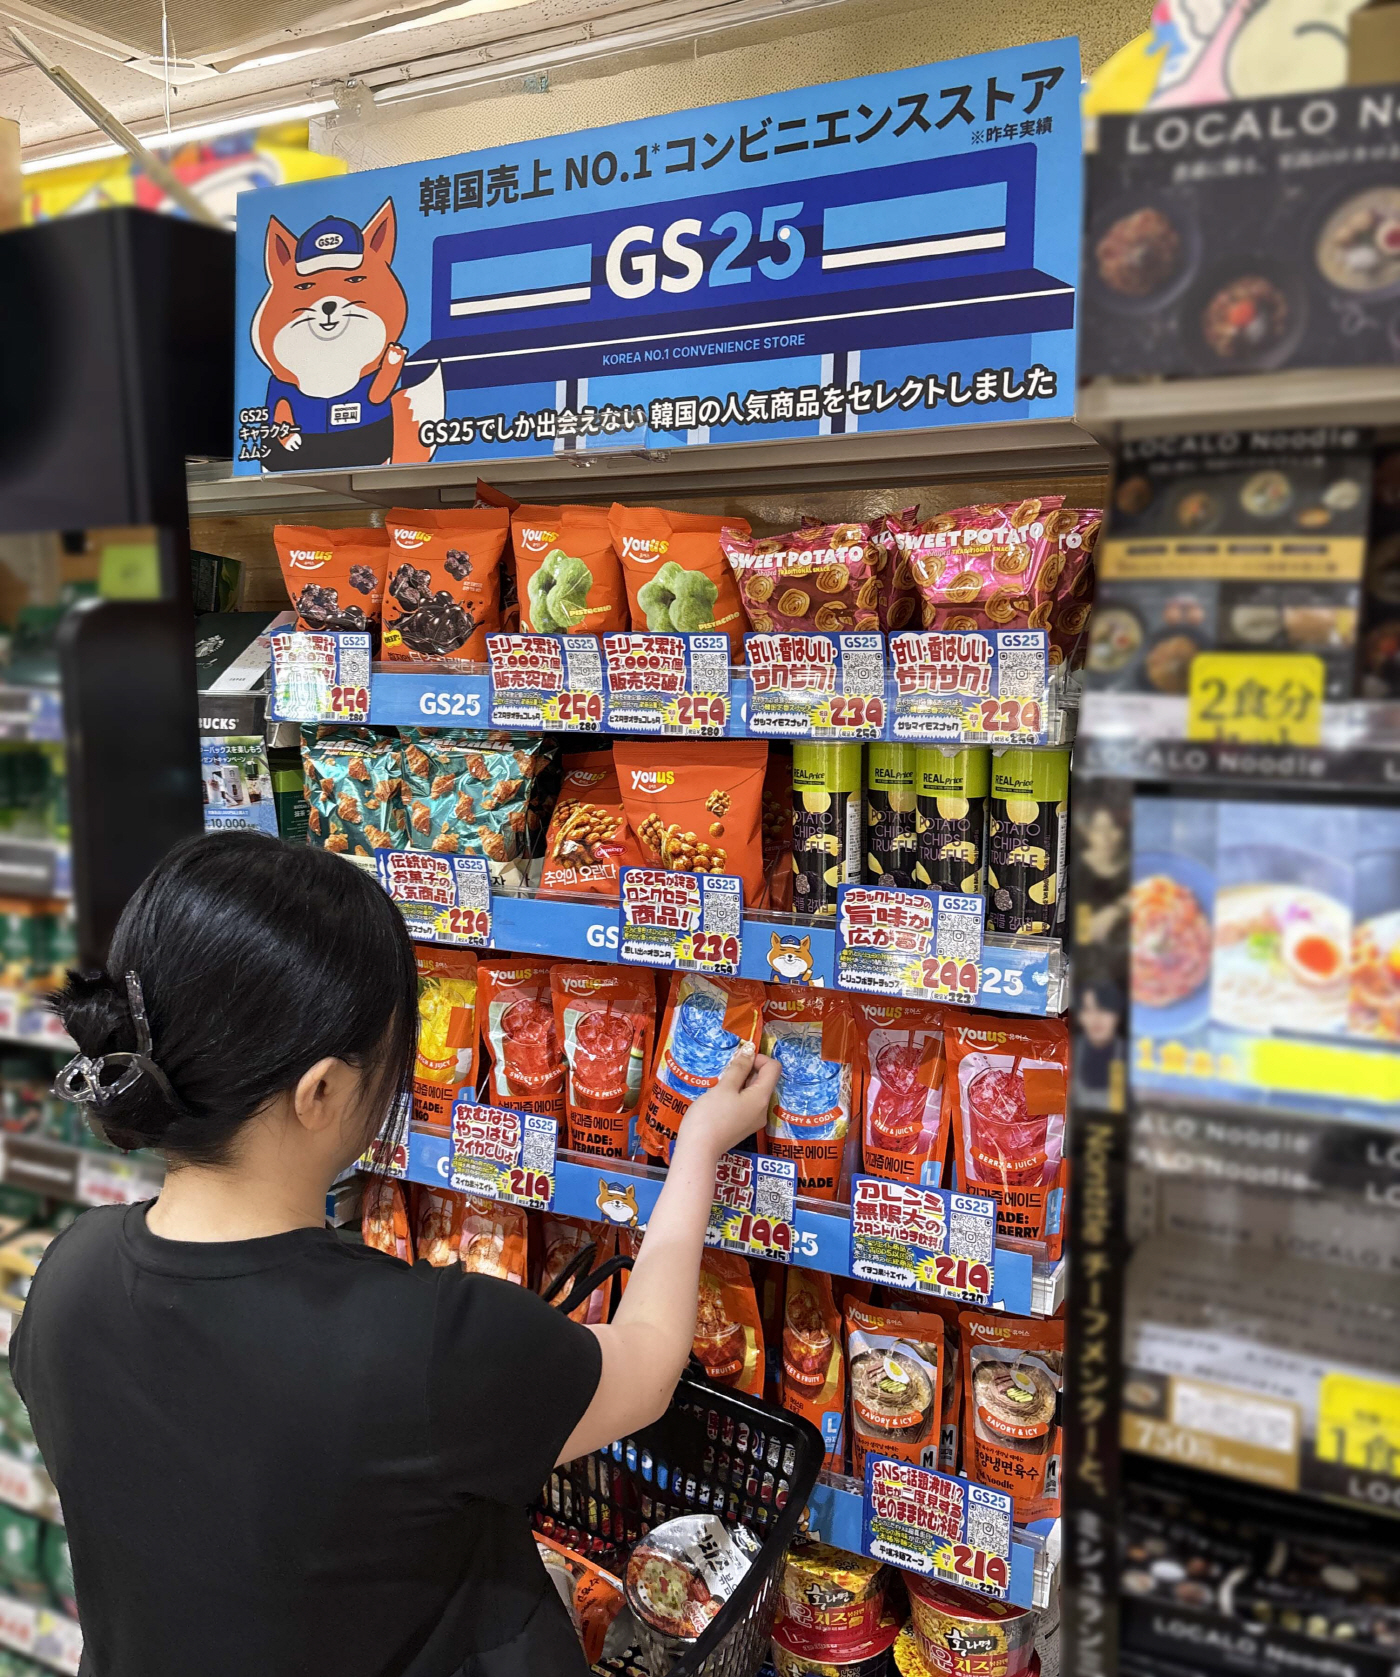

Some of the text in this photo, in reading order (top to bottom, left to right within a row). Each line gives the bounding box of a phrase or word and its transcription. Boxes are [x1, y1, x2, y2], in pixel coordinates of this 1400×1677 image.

[970, 115, 1053, 146] ※昨年実績
[1126, 100, 1338, 155] LOCALO
[419, 158, 555, 217] 韓国売上
[664, 65, 1065, 174] コンビニエンスストア
[316, 234, 341, 247] GS25
[604, 201, 807, 298] GS25
[602, 333, 806, 366] KOREA NO.1 CONVENIENCE STORE
[239, 408, 269, 423] GS25
[419, 367, 1056, 447] GS25でしか出会えない 韓国の人気商品をセレクトしました
[239, 423, 301, 441] キャラクター
[1251, 429, 1358, 451] Noodle
[239, 445, 272, 459] ムムシ
[394, 528, 433, 547] youus
[521, 528, 560, 548] youus
[896, 522, 1044, 550] SWEET POTATO
[622, 536, 670, 557] youus
[289, 550, 333, 567] youus
[730, 545, 864, 570] SWEET POTATO
[569, 604, 612, 617] PISTACHIO
[698, 612, 740, 632] PISTACHIO
[342, 636, 367, 646] GS25
[488, 637, 560, 657] シリーズ累計
[567, 639, 594, 650] GS25
[605, 636, 685, 657] シリーズ累計
[693, 637, 724, 649] GS25
[844, 636, 878, 648] GS25
[1001, 634, 1040, 647] GS25
[608, 655, 684, 671] 3,000万個
[608, 670, 685, 692] 販売突破!
[419, 692, 481, 716] GS25
[557, 693, 603, 721] 259
[1199, 677, 1315, 723] 2食分
[677, 696, 725, 726] 259
[829, 696, 884, 728] 239
[980, 699, 1042, 733] 239
[631, 770, 675, 790] youus
[793, 768, 808, 779] REAL
[874, 767, 895, 778] REAL
[923, 772, 944, 784] REAL
[995, 774, 1014, 785] REAL
[793, 825, 824, 839] CHIPS
[874, 825, 911, 839] CHIPS
[919, 815, 971, 833] POTATO
[922, 831, 962, 848] CHIPS
[993, 835, 1031, 852] CHIPS
[390, 854, 448, 872] 伝統的な
[919, 845, 969, 863] TRUFFLE
[457, 859, 484, 870] GS25
[393, 870, 451, 888] お菓子の
[543, 863, 617, 888] 추억의 오란다
[706, 878, 736, 890] GS25
[390, 885, 455, 905] 人気商品!
[626, 887, 700, 906] ロングセラー
[845, 891, 932, 910] ブラックトリュフの
[942, 897, 978, 911] GS25
[449, 908, 489, 937] 239
[631, 904, 690, 928] 商品!
[844, 905, 930, 929] 旨味が
[691, 932, 739, 965] 239
[848, 928, 928, 952] 広がる!
[489, 969, 532, 985] youus
[922, 958, 979, 994] 299
[982, 967, 1024, 996] 25
[861, 1004, 903, 1020] youus
[958, 1026, 1007, 1043] youus
[667, 1058, 711, 1086] ZESTY COOL
[575, 1081, 595, 1096] SWEET
[456, 1104, 519, 1130] 飲むなら
[528, 1117, 554, 1131] GS25
[781, 1112, 834, 1125] ZESTY COOL
[455, 1120, 518, 1148] やっぱり
[586, 1132, 613, 1146] ADE:
[895, 1125, 914, 1137] JUICY
[454, 1138, 519, 1165] スイカでしょ!
[761, 1160, 791, 1175] GS25
[978, 1153, 1037, 1171] BERRY JUICY
[510, 1168, 551, 1202] 219
[955, 1197, 989, 1214] GS25
[855, 1201, 941, 1233] 無限大の
[996, 1211, 1030, 1225] ADE:
[738, 1214, 792, 1252] 199
[935, 1255, 990, 1294] 219
[848, 1306, 885, 1327] youus
[969, 1321, 1011, 1338] youus
[710, 1363, 737, 1375] FRUITY
[801, 1373, 820, 1384] FRUITY
[827, 1417, 837, 1433] L
[860, 1408, 913, 1426] SAVORY ICY
[986, 1414, 1038, 1437] SAVORY ICY
[941, 1429, 954, 1446] M
[922, 1450, 933, 1467] M
[972, 1489, 1006, 1509] GS25
[953, 1544, 1008, 1589] 219
[814, 1611, 848, 1626] 치즈
[953, 1657, 990, 1673] 치즈
